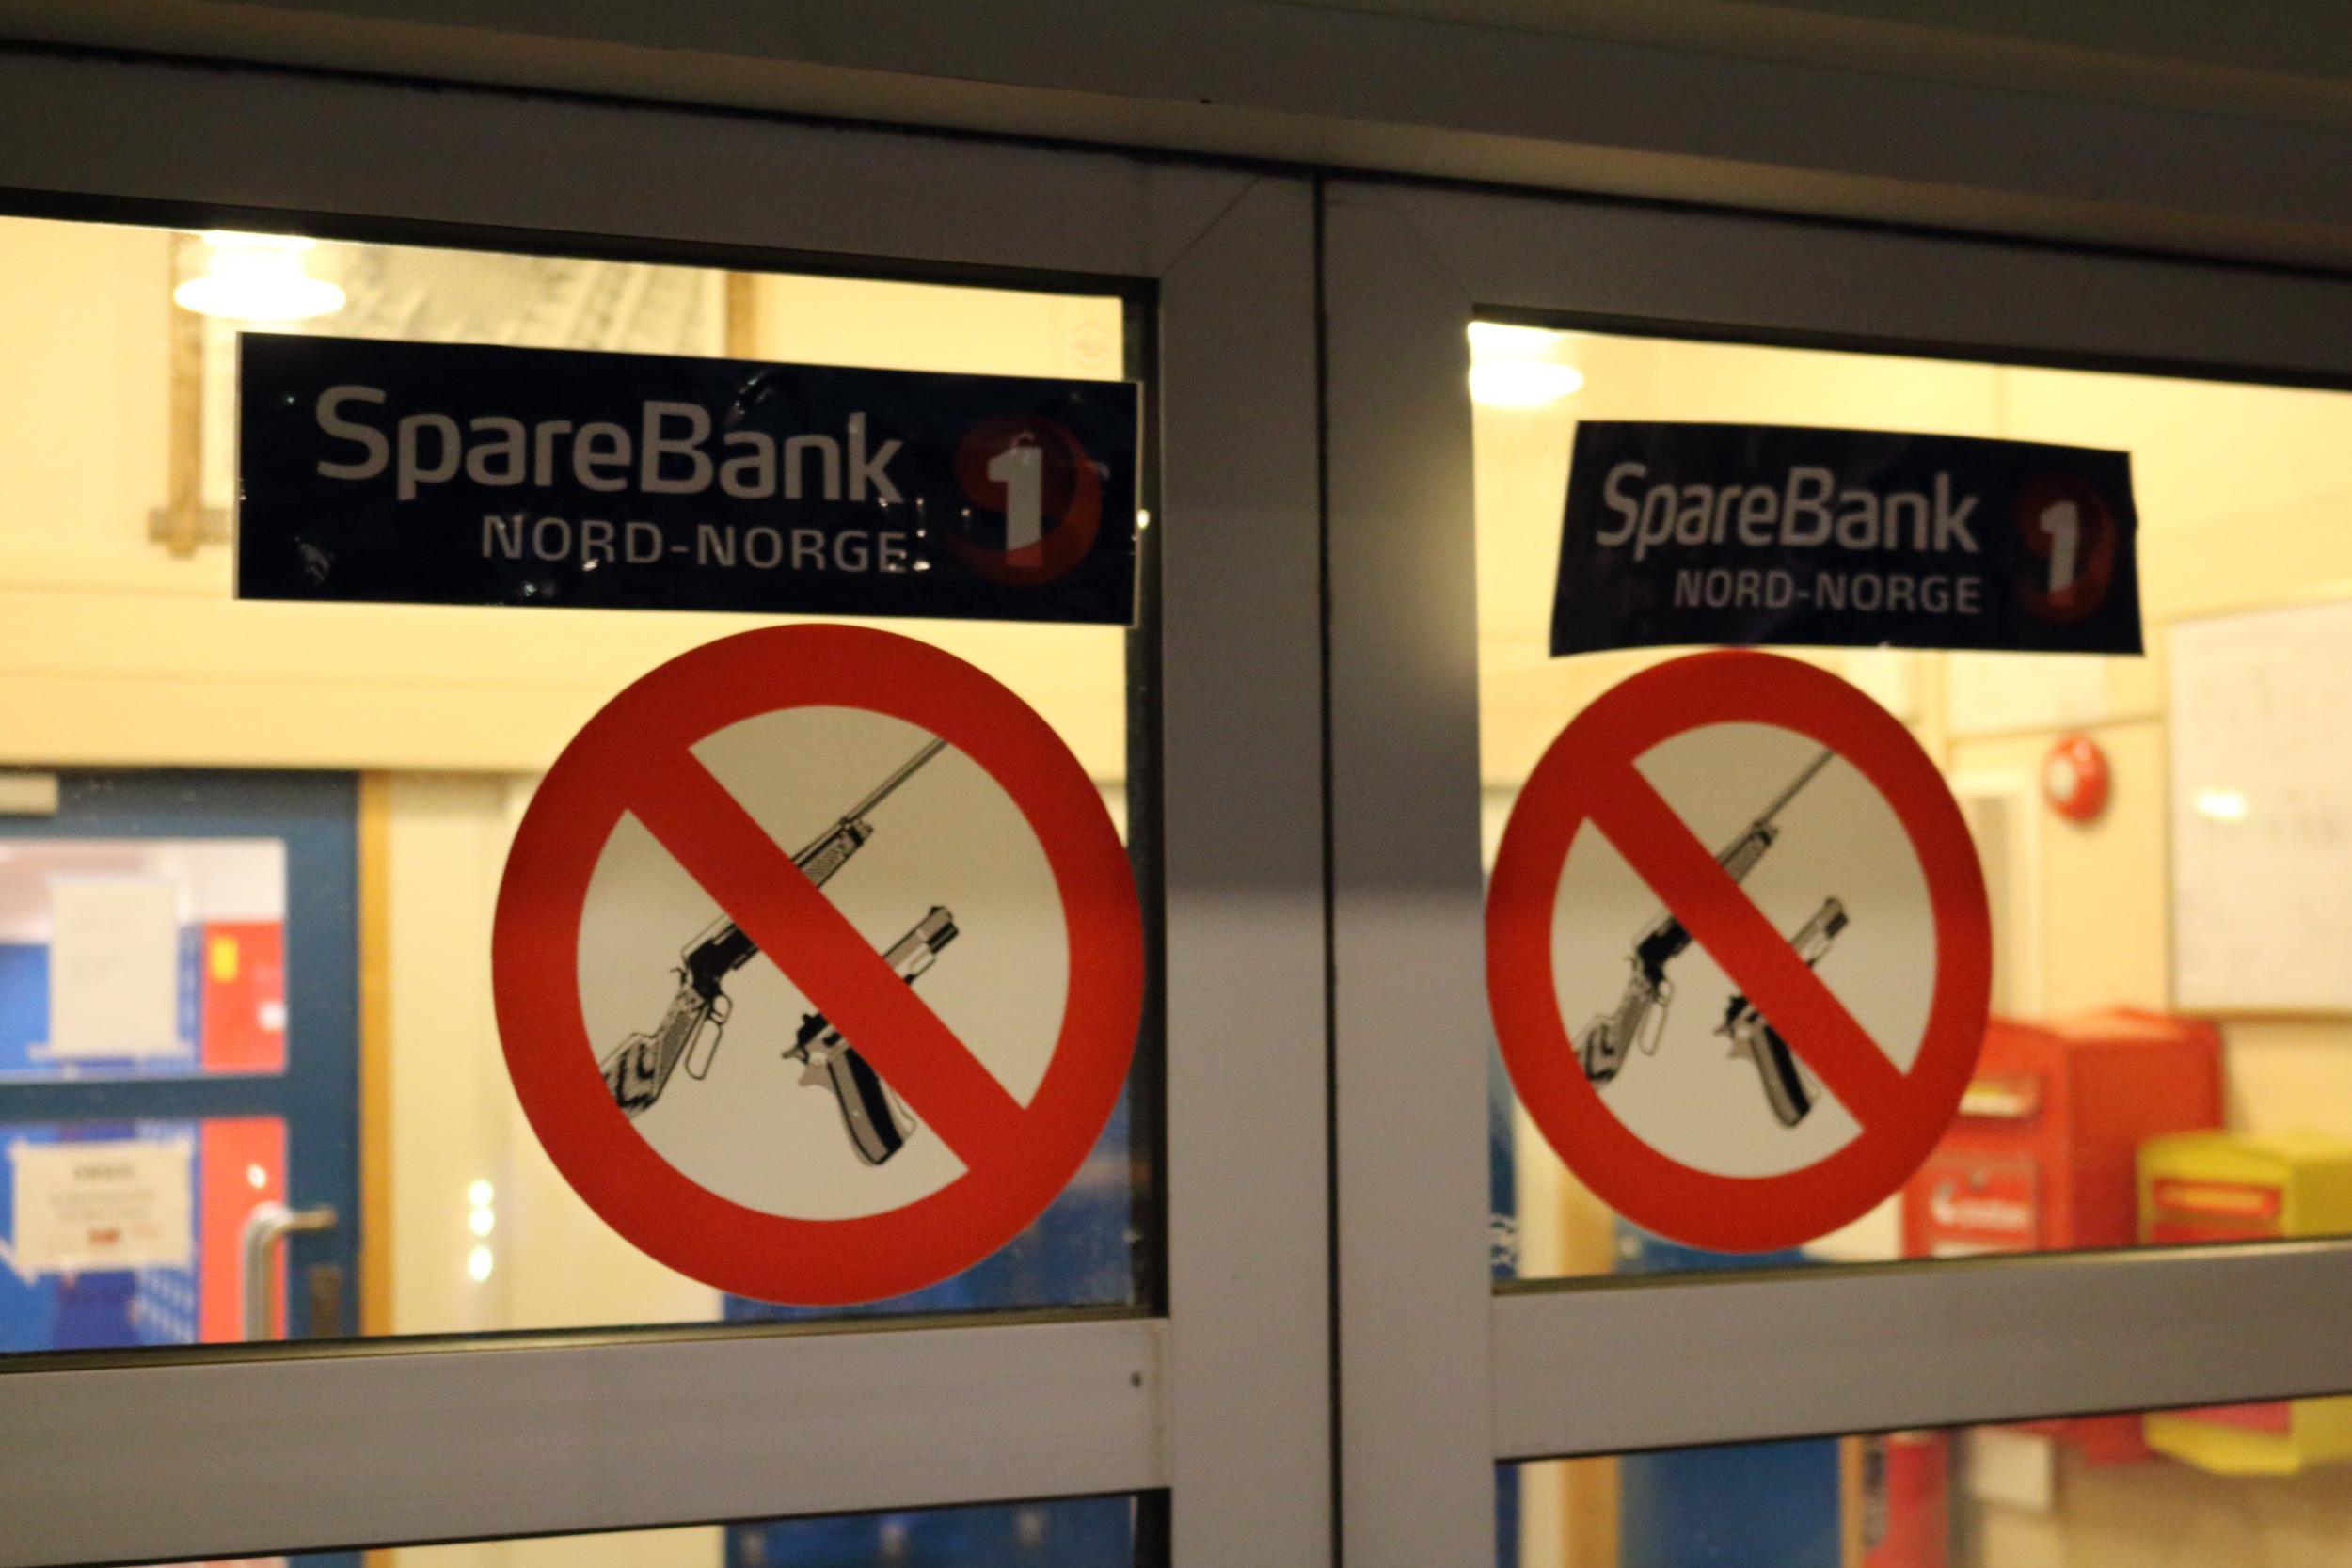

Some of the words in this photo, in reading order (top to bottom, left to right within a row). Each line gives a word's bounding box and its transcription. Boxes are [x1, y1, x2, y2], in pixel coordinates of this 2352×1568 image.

[314, 384, 904, 504] SpareBank
[987, 442, 1043, 568] 1
[481, 515, 910, 574] NORD-NORGE
[1596, 461, 1981, 562] SpareBank
[2040, 500, 2079, 605] 1
[1672, 569, 1982, 614] NORD-NORGE
